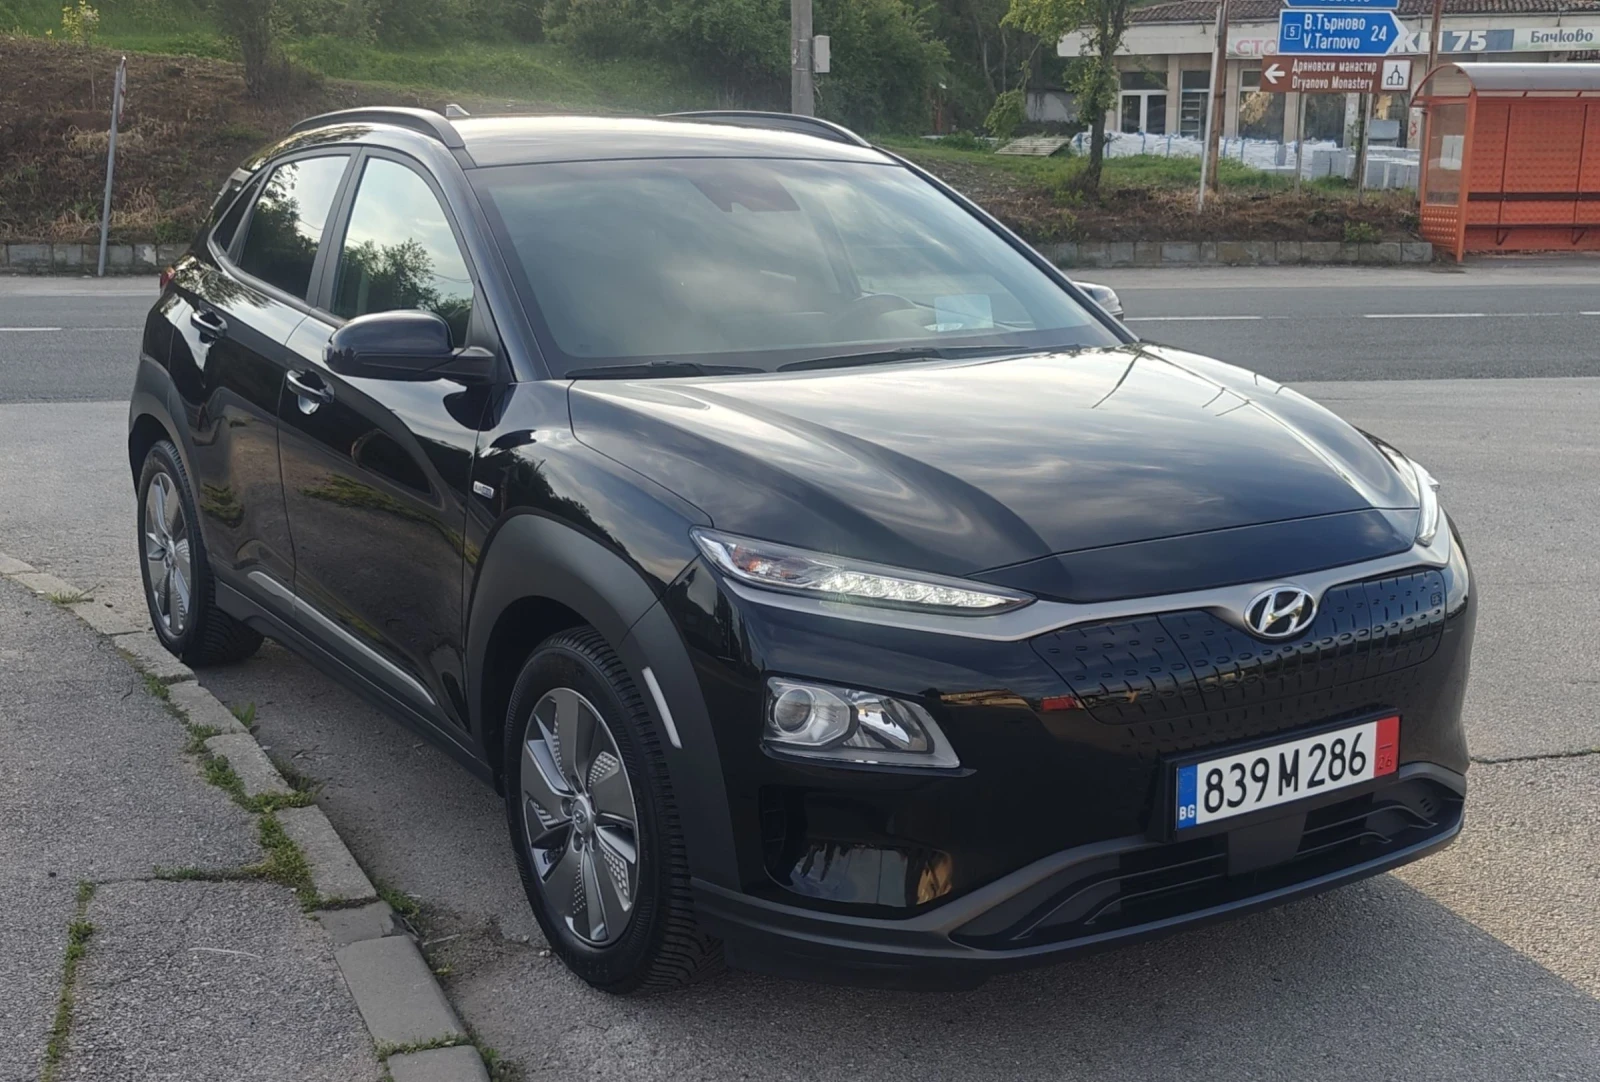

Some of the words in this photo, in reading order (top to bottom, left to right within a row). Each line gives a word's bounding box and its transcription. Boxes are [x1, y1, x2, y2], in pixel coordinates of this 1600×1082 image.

[1289, 26, 1296, 37] 5
[1303, 13, 1366, 34] В.Търново
[1303, 32, 1361, 50] V.Tarnovo
[1370, 25, 1388, 42] 24
[1452, 30, 1487, 52] 75
[1530, 28, 1594, 44] Бачково
[1291, 58, 1336, 75] Дряновски
[1339, 61, 1378, 76] манастир
[1291, 75, 1329, 92] Dryanovo
[1331, 75, 1374, 92] Monastery
[1179, 804, 1196, 821] BG
